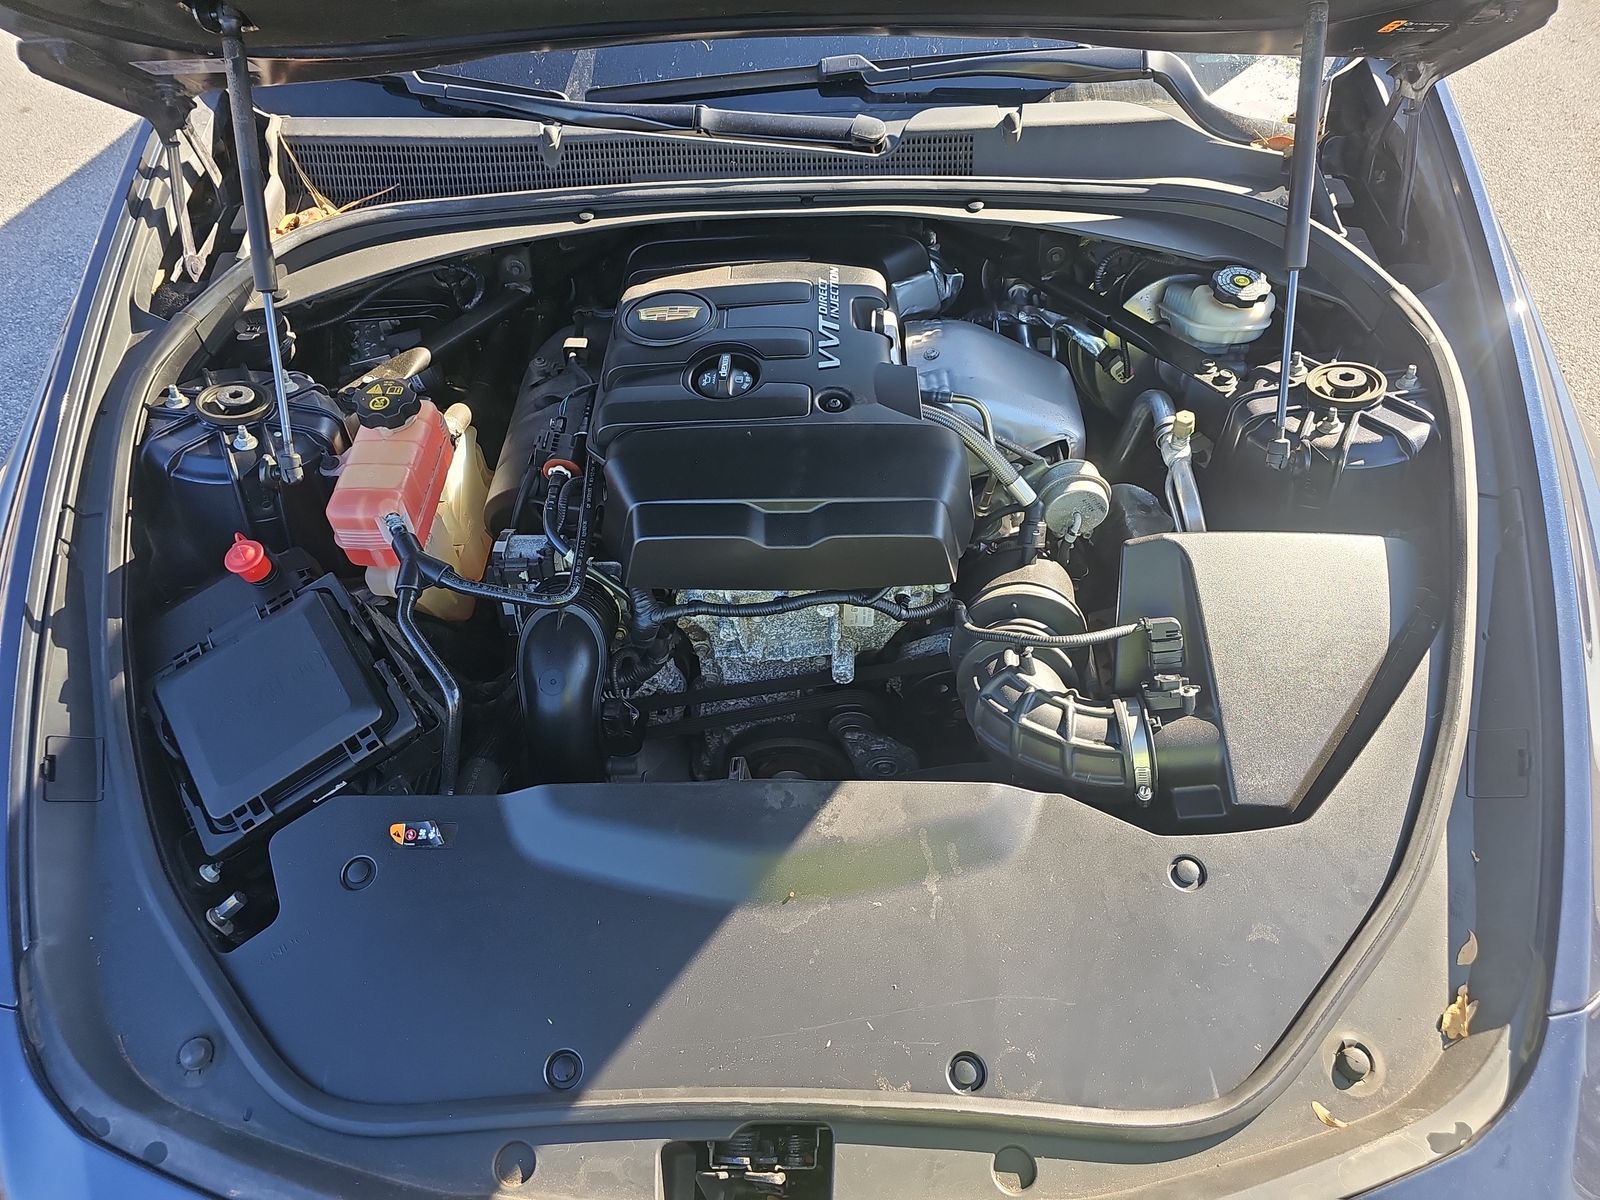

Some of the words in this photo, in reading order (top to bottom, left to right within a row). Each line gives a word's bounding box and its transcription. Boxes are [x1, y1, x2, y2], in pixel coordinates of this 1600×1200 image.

[818, 276, 828, 316] DIRECT
[829, 266, 840, 319] INJECTION
[818, 314, 841, 370] VVT
[719, 355, 730, 377] dexos
